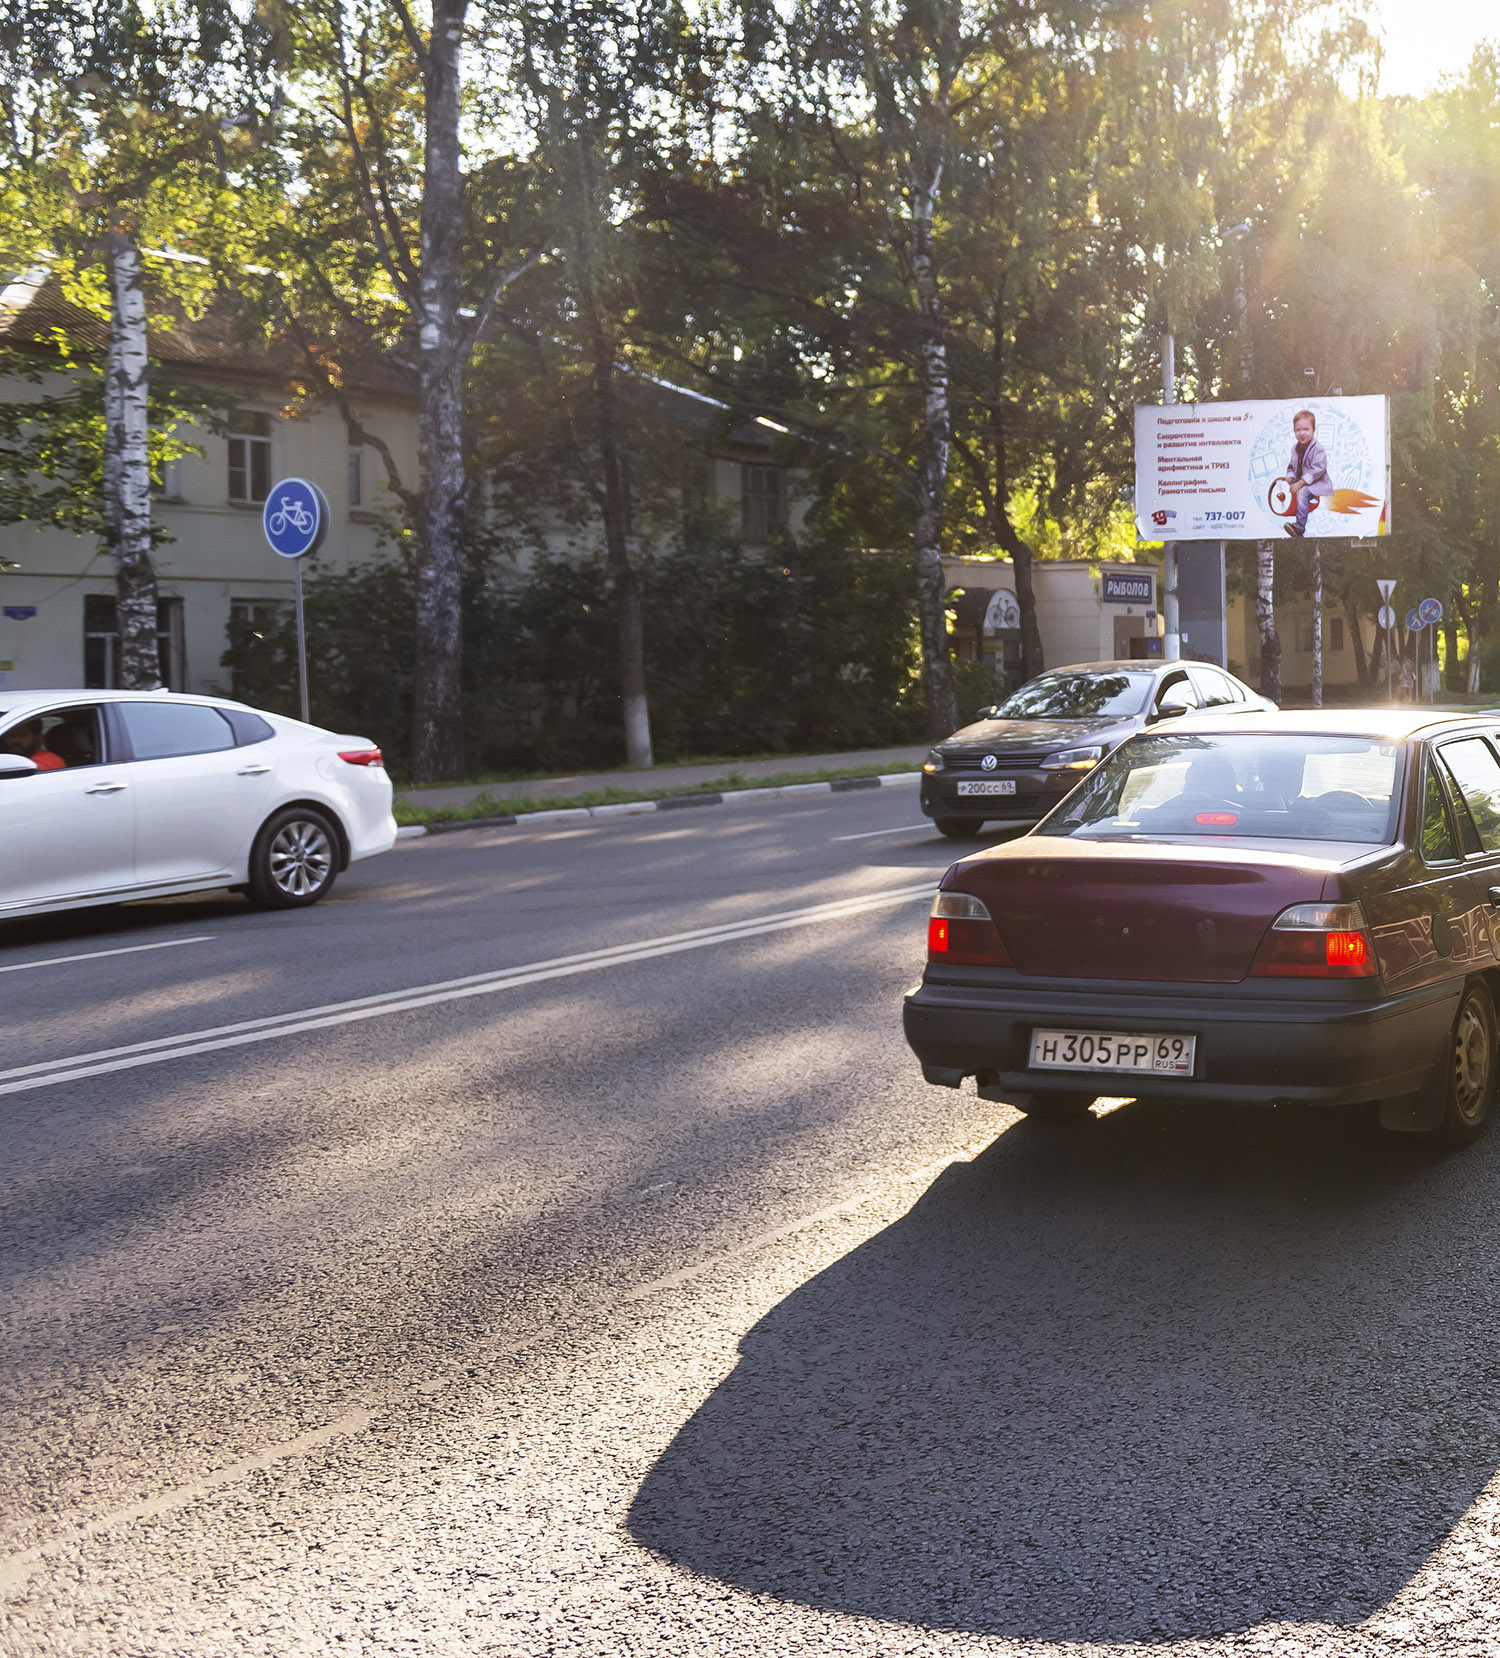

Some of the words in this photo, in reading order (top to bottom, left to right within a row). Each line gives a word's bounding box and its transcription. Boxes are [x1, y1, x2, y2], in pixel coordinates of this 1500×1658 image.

[1157, 417, 1200, 425] Подготовка
[1157, 432, 1204, 440] Скорочтение
[1163, 441, 1197, 449] развитие
[1199, 439, 1242, 447] интеллекта
[1158, 464, 1203, 472] арифметика
[1158, 487, 1197, 495] Грамотное
[1205, 511, 1246, 521] 737-007
[1107, 580, 1149, 597] РЫБОЛОВ
[1001, 781, 1012, 791] 69
[1042, 1035, 1148, 1066] Н305РР
[1156, 1037, 1184, 1060] 69
[1155, 1061, 1175, 1069] RUS
